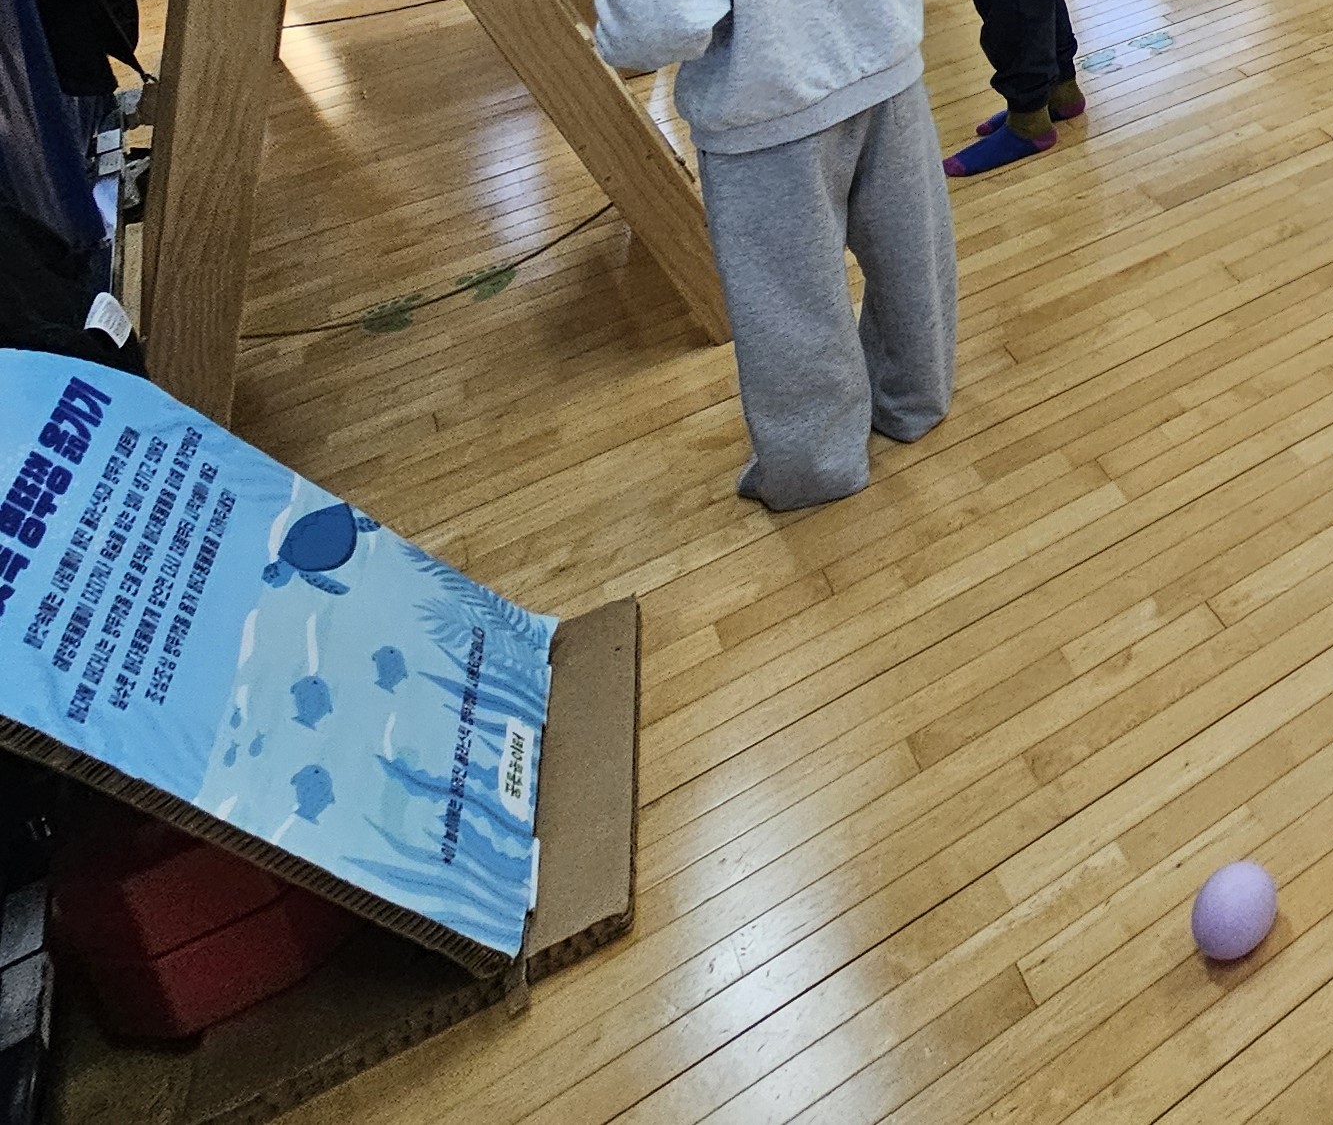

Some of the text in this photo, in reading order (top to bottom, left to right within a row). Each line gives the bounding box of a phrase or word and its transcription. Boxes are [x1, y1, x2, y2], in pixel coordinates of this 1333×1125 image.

[38, 376, 112, 465] 옮기기
[52, 548, 82, 592] 사람들이
[80, 482, 113, 530] 플라스틱과
[102, 455, 126, 484] 병뚜껑
[115, 427, 139, 458] 때문에
[169, 519, 195, 557] 처음부터
[53, 603, 93, 671] 해양동물들이
[81, 561, 112, 604] 다치거나
[100, 530, 126, 561] 목숨을
[132, 462, 157, 491] 생기고
[160, 554, 181, 578] 다시
[83, 639, 115, 684] 떠다니는
[102, 595, 132, 638] 병뚜껑을
[145, 657, 176, 704] 조심조심
[163, 615, 191, 657] 병뚜껑을
[108, 673, 136, 710] 실수로
